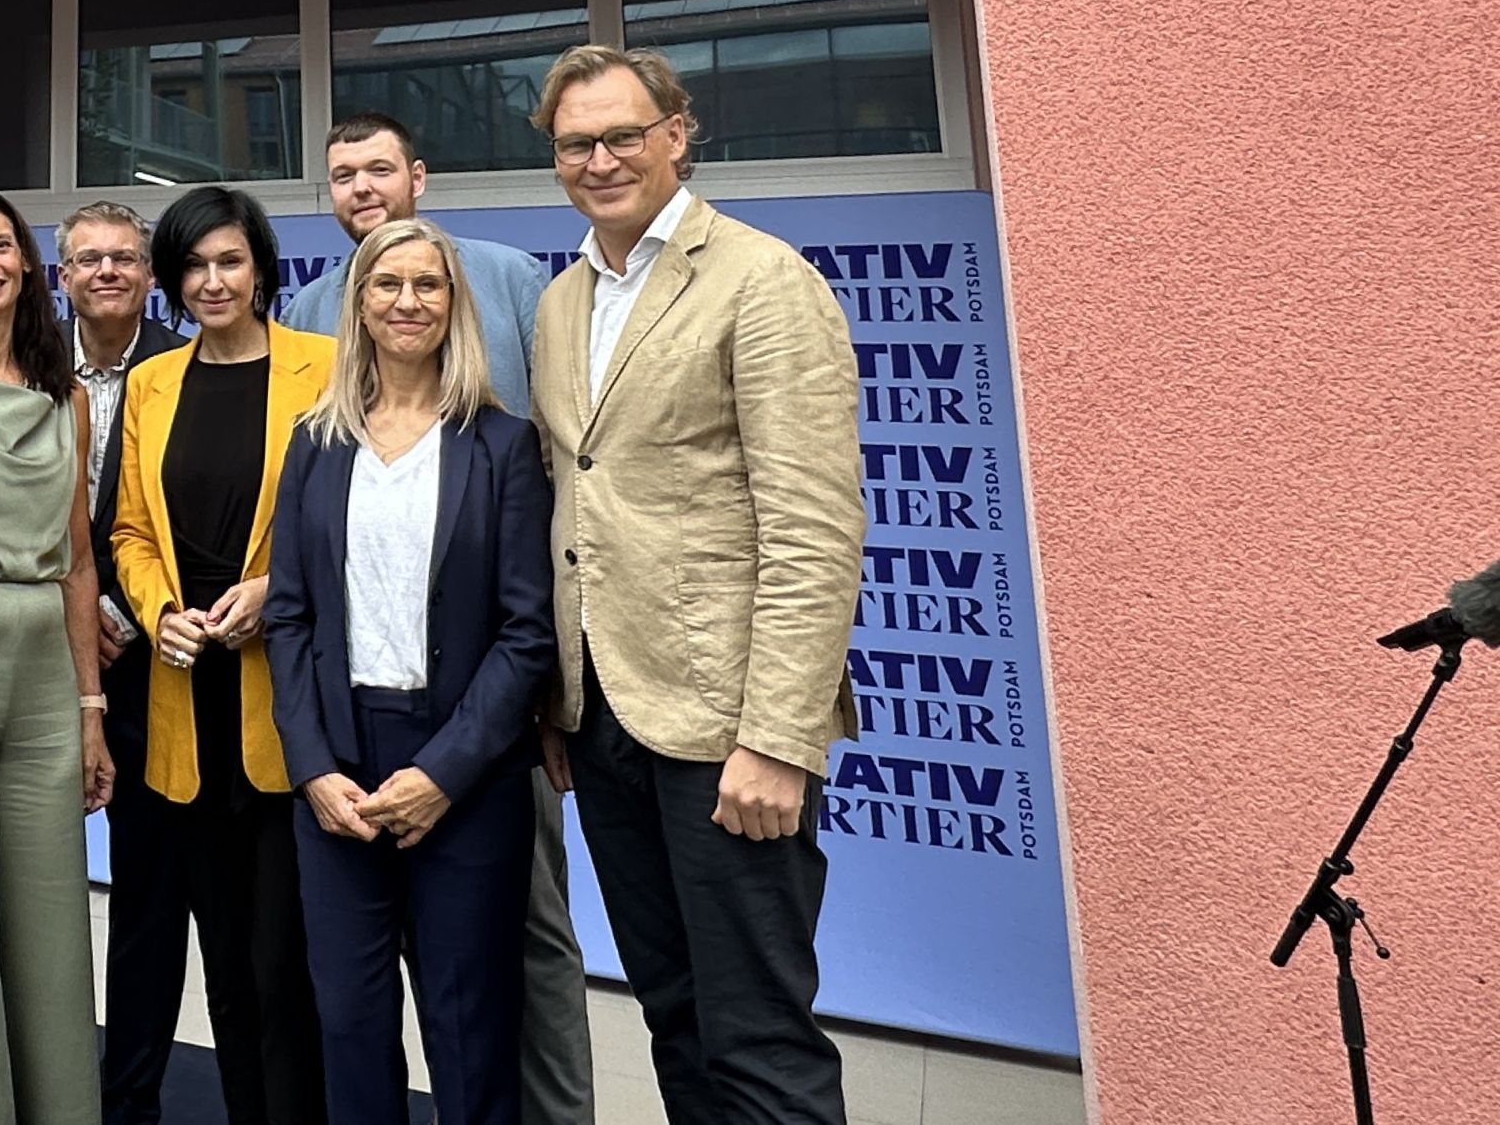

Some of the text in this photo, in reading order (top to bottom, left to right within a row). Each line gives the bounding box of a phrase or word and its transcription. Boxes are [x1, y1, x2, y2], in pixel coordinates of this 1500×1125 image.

[961, 241, 984, 323] POTSDAM
[973, 343, 994, 426] POTSDAM
[982, 446, 1004, 531] POTSDAM
[861, 545, 983, 589] TIV
[992, 552, 1014, 639] POTSDAM
[854, 692, 1003, 747] TIER
[1003, 660, 1027, 749] POTSDAM
[824, 751, 1005, 808] ATIV
[1015, 770, 1039, 861] POTSDAM
[818, 794, 1015, 858] RTIER
